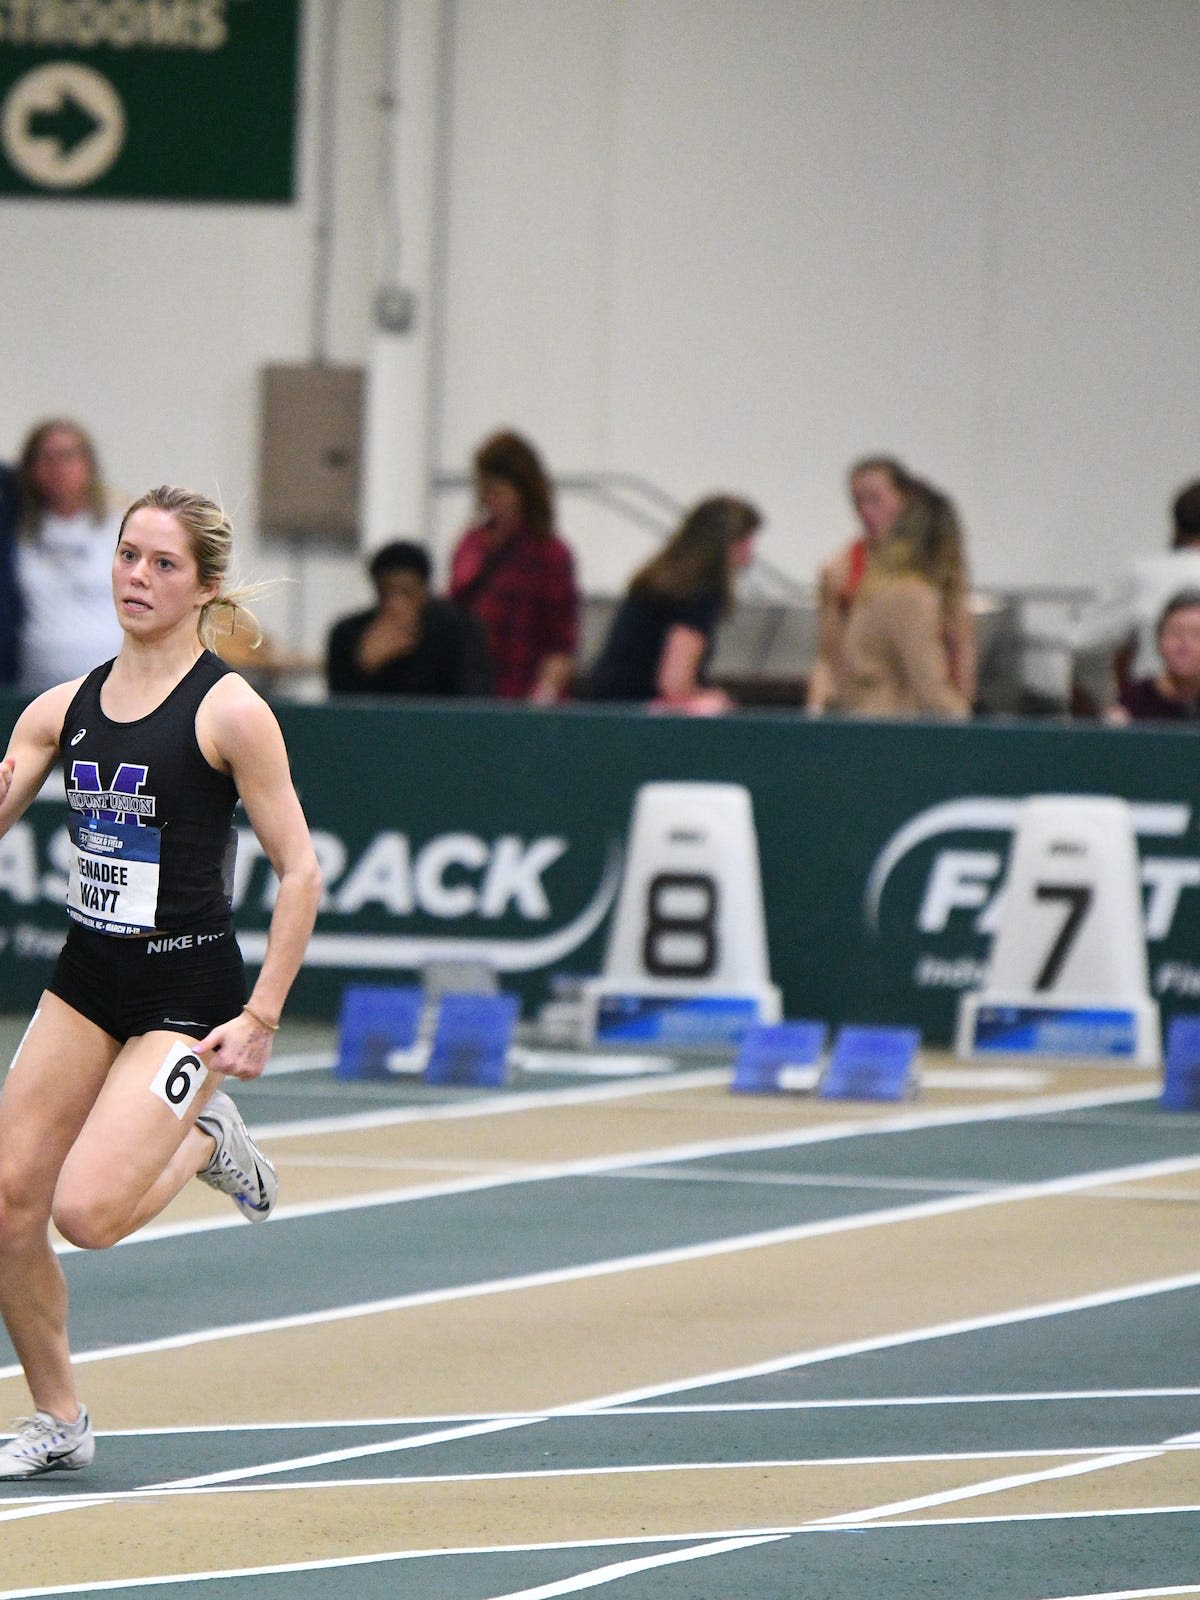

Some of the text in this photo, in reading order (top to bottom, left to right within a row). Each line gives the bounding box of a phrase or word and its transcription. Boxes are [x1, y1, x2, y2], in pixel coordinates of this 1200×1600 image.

[109, 794, 153, 814] UNION
[80, 881, 120, 913] WAYT
[146, 935, 193, 954] NIKE
[643, 873, 719, 978] 8
[1032, 883, 1092, 993] 7
[165, 1055, 201, 1105] 6
